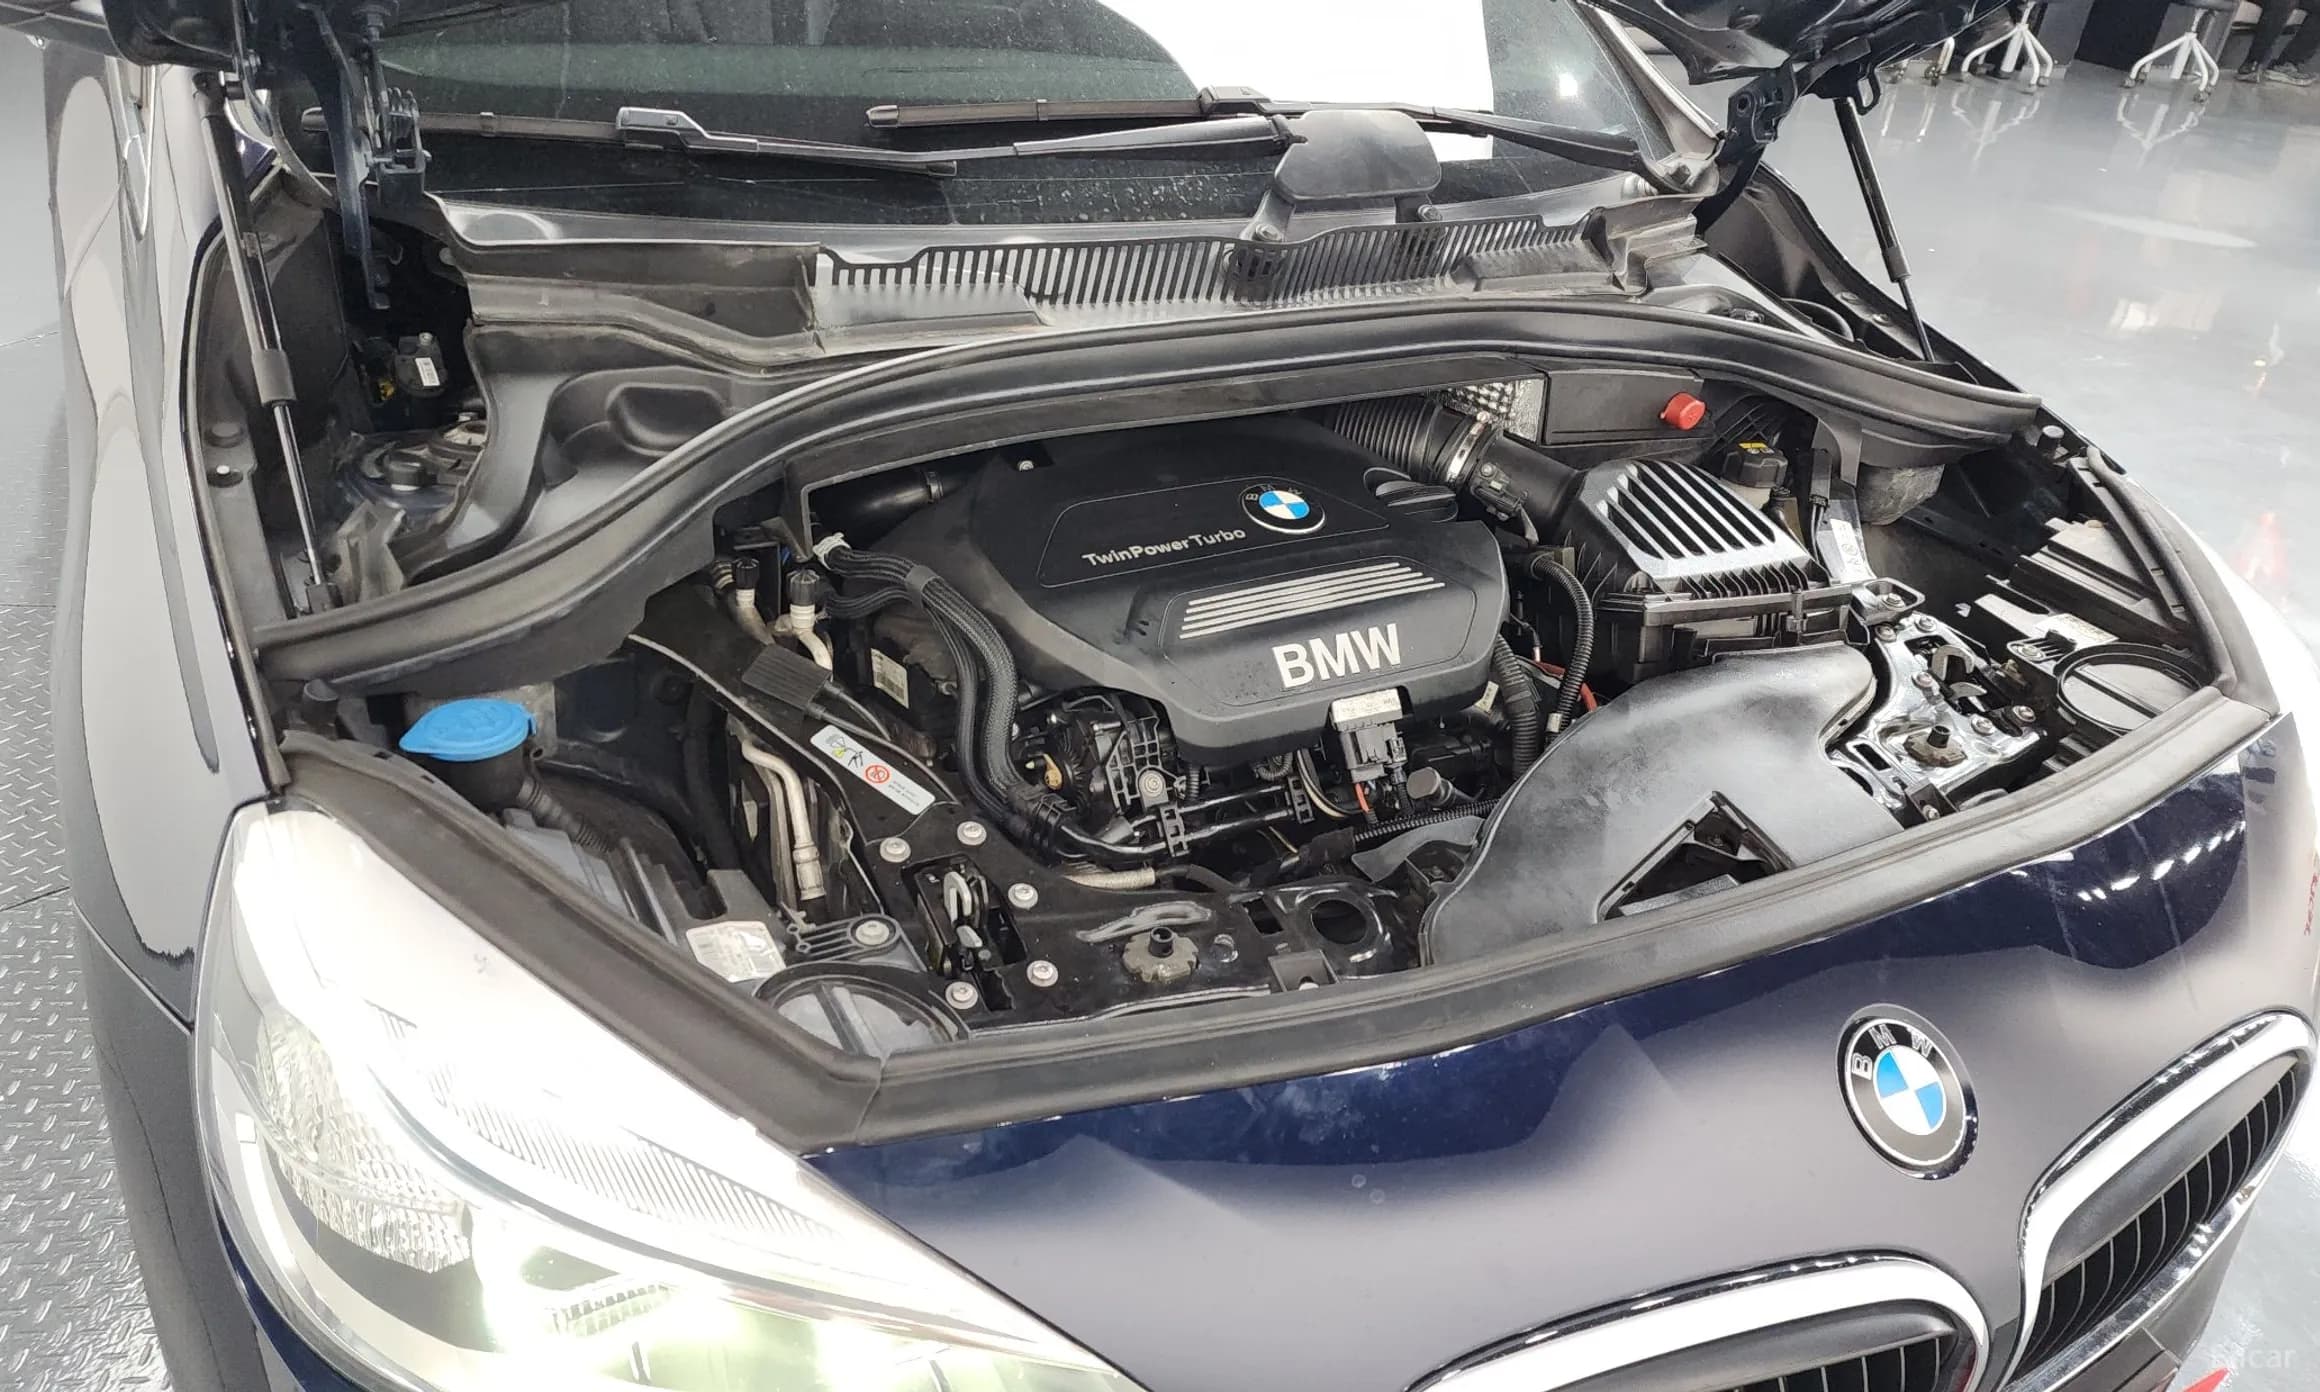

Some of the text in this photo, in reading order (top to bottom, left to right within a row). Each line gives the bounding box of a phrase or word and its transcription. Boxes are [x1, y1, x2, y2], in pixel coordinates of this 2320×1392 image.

[1188, 528, 1247, 549] Turbo
[1271, 623, 1401, 688] BMW
[1851, 1023, 1933, 1081] BMW
